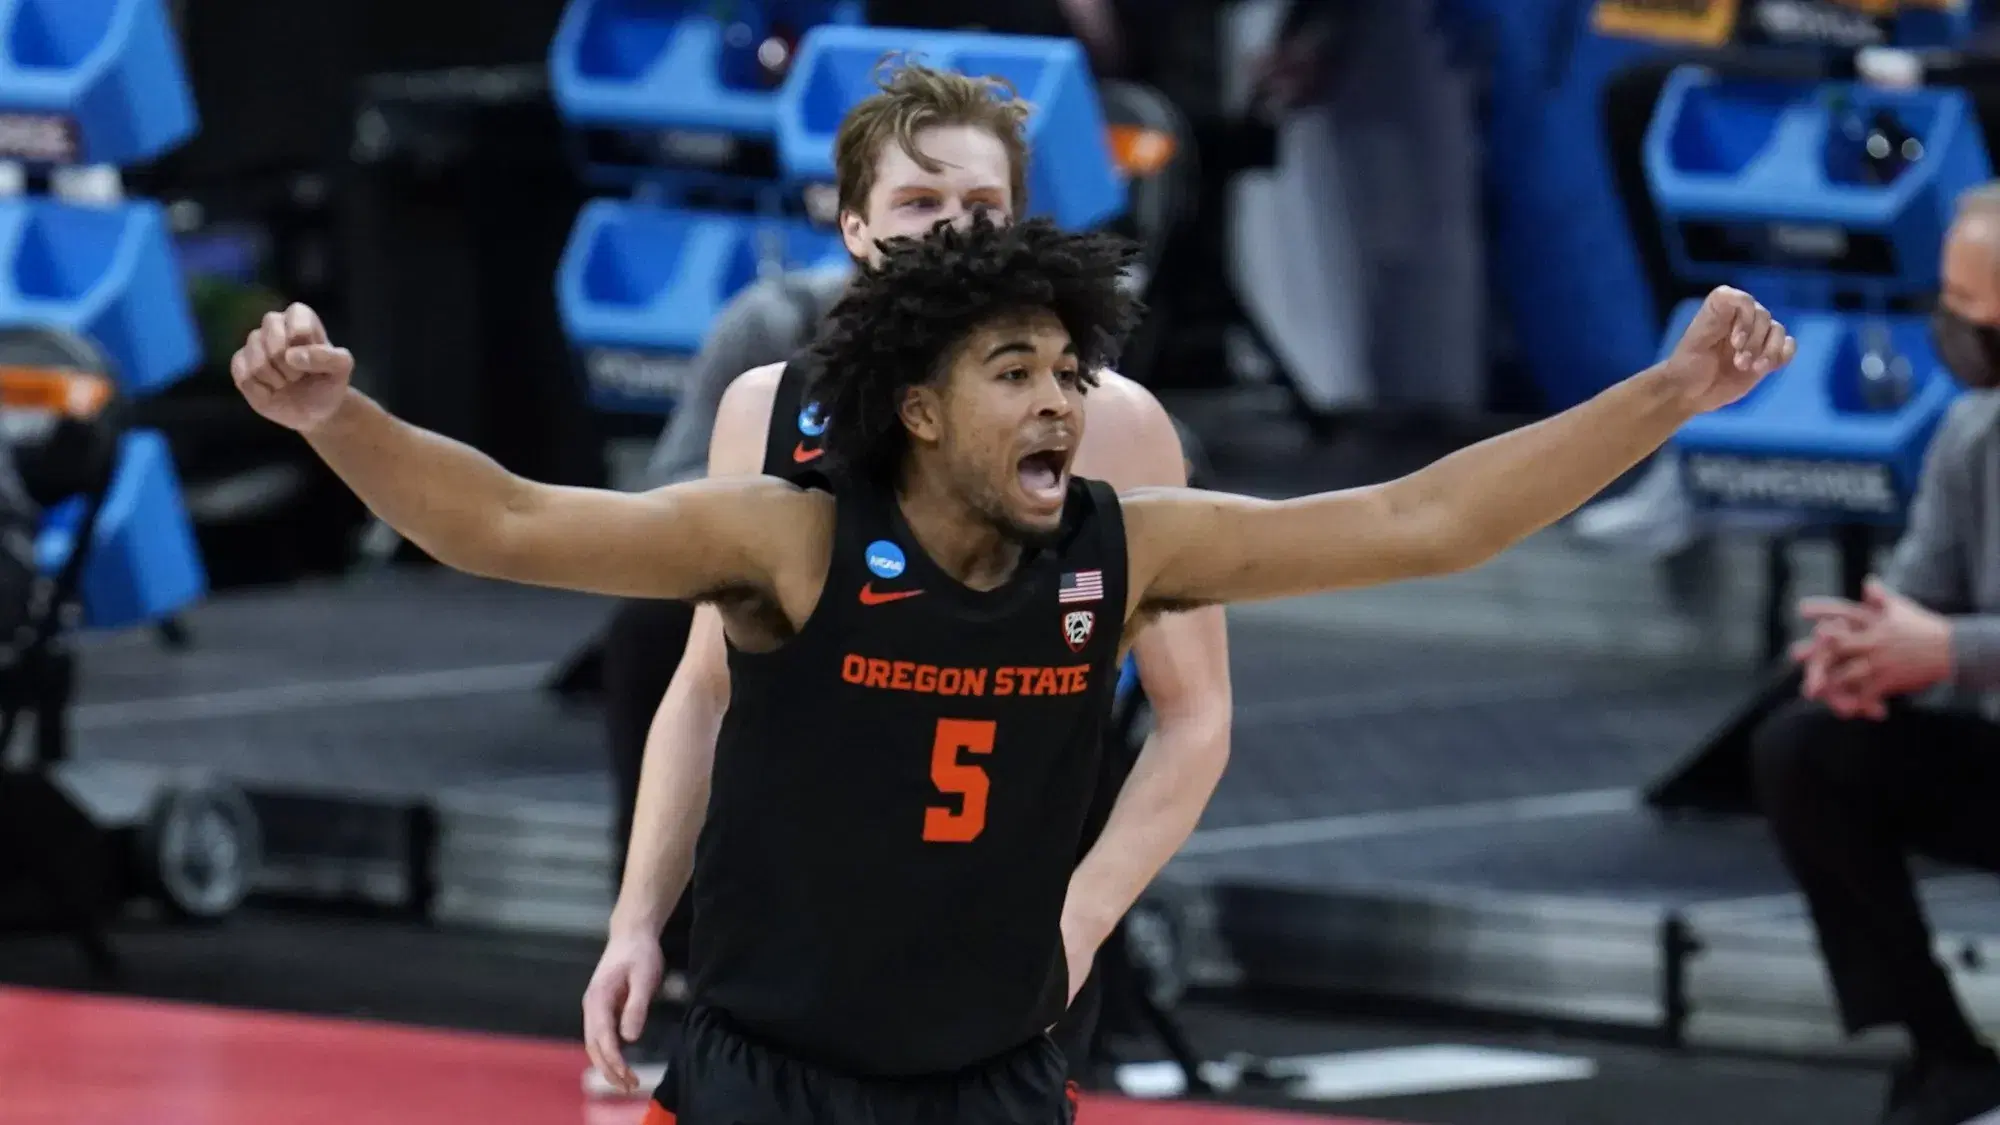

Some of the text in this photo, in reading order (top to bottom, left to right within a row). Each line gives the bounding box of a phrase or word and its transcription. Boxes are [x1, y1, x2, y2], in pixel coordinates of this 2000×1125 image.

[842, 654, 1090, 696] OREGON STATE
[923, 718, 996, 842] 5
